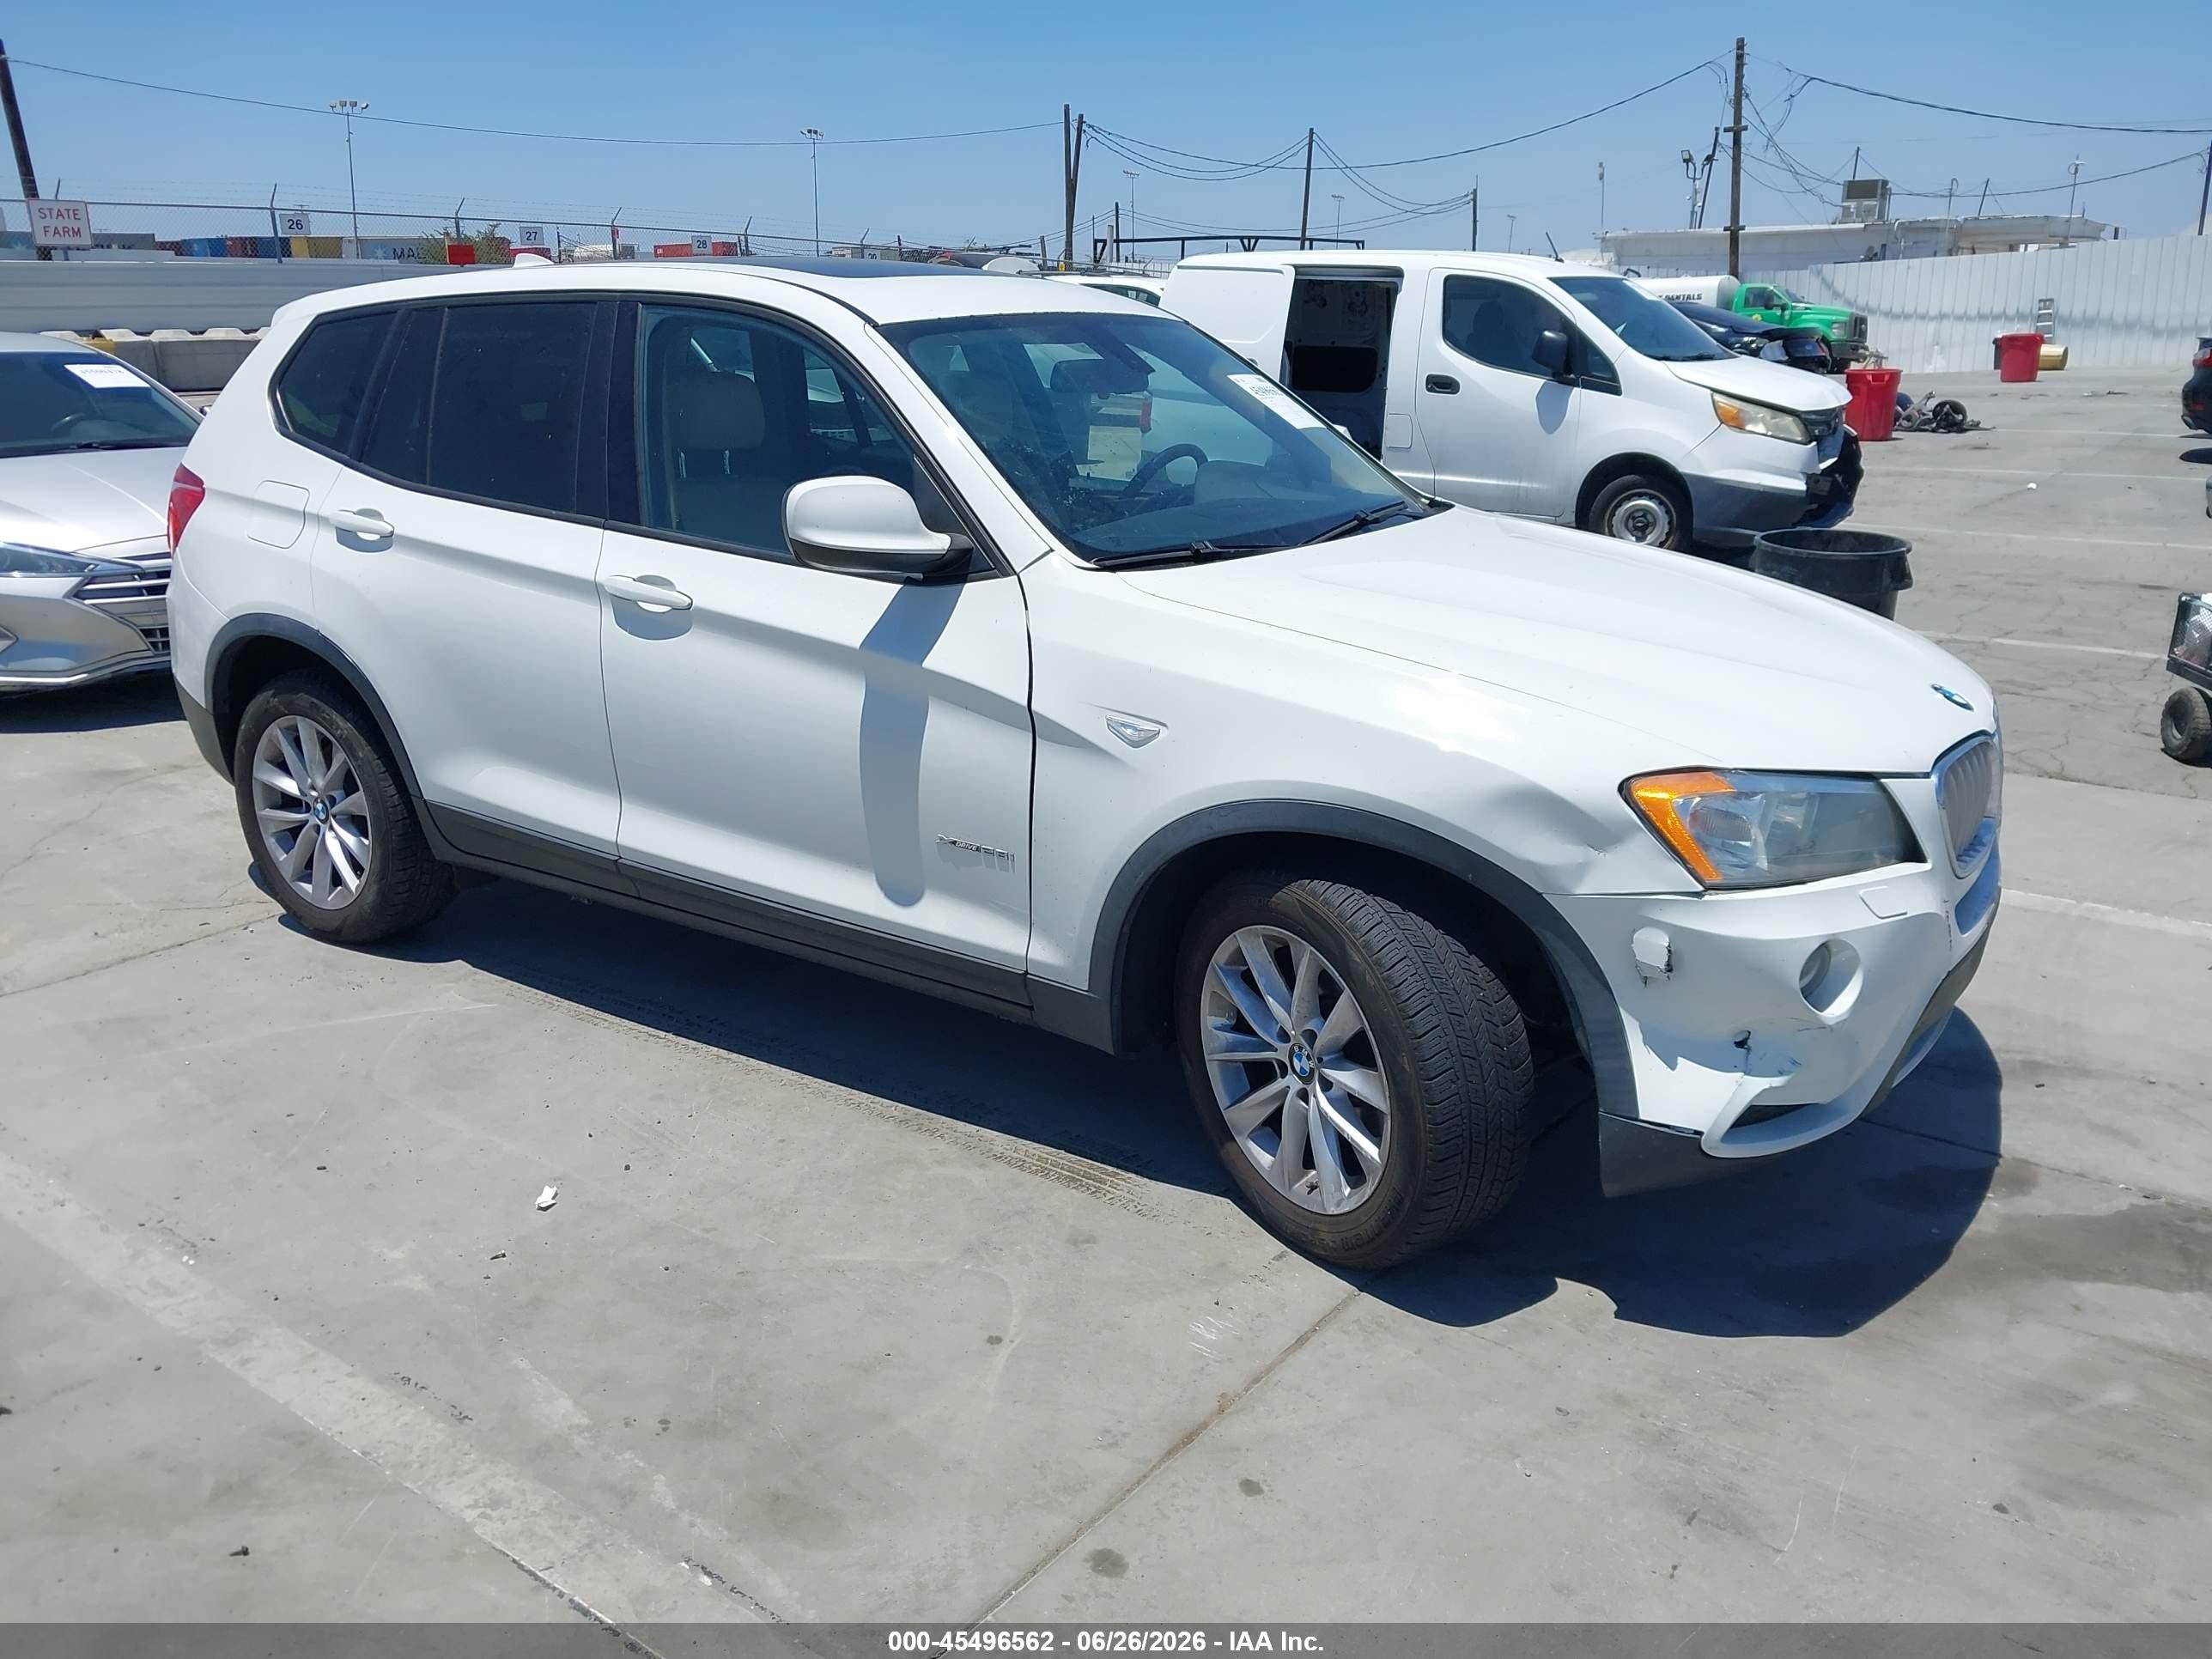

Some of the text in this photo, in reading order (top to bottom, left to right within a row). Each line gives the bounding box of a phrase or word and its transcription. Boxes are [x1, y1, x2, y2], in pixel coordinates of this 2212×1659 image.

[38, 207, 81, 221] STATE
[287, 218, 303, 230] 26
[43, 226, 82, 238] FARM
[526, 231, 538, 241] 27
[696, 240, 708, 249] 28
